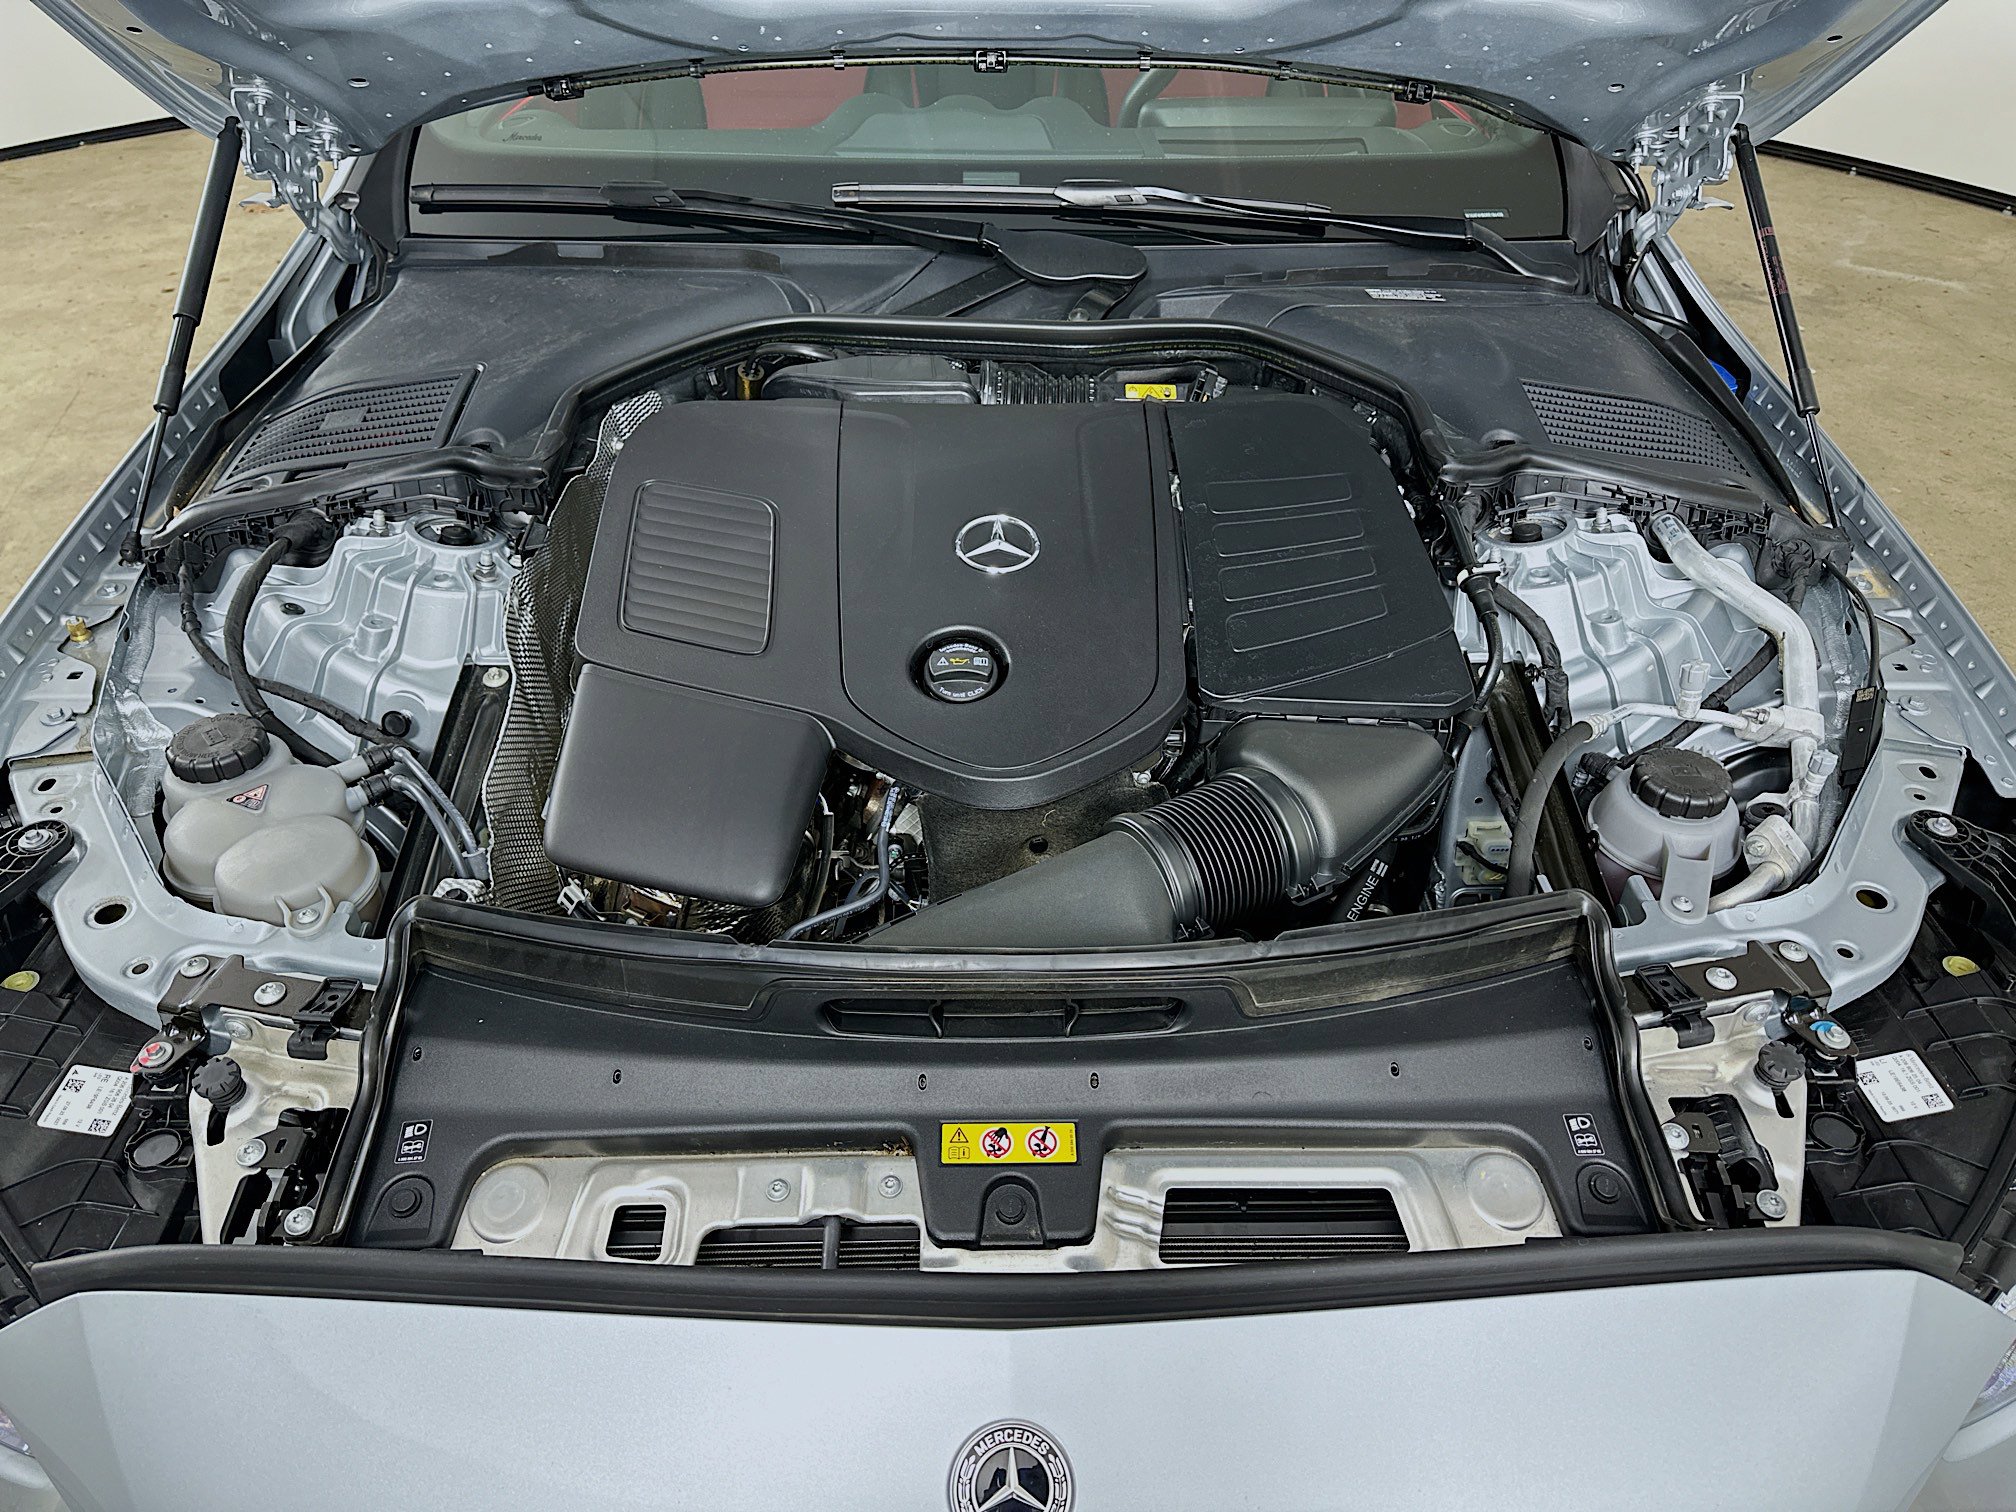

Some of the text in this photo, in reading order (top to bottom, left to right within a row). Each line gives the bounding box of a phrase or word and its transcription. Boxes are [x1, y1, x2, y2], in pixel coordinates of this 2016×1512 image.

[939, 686, 952, 697] Turn
[967, 686, 985, 697] CLICK
[1346, 875, 1380, 922] ENGINE
[973, 1428, 1050, 1457] MERCEDES
